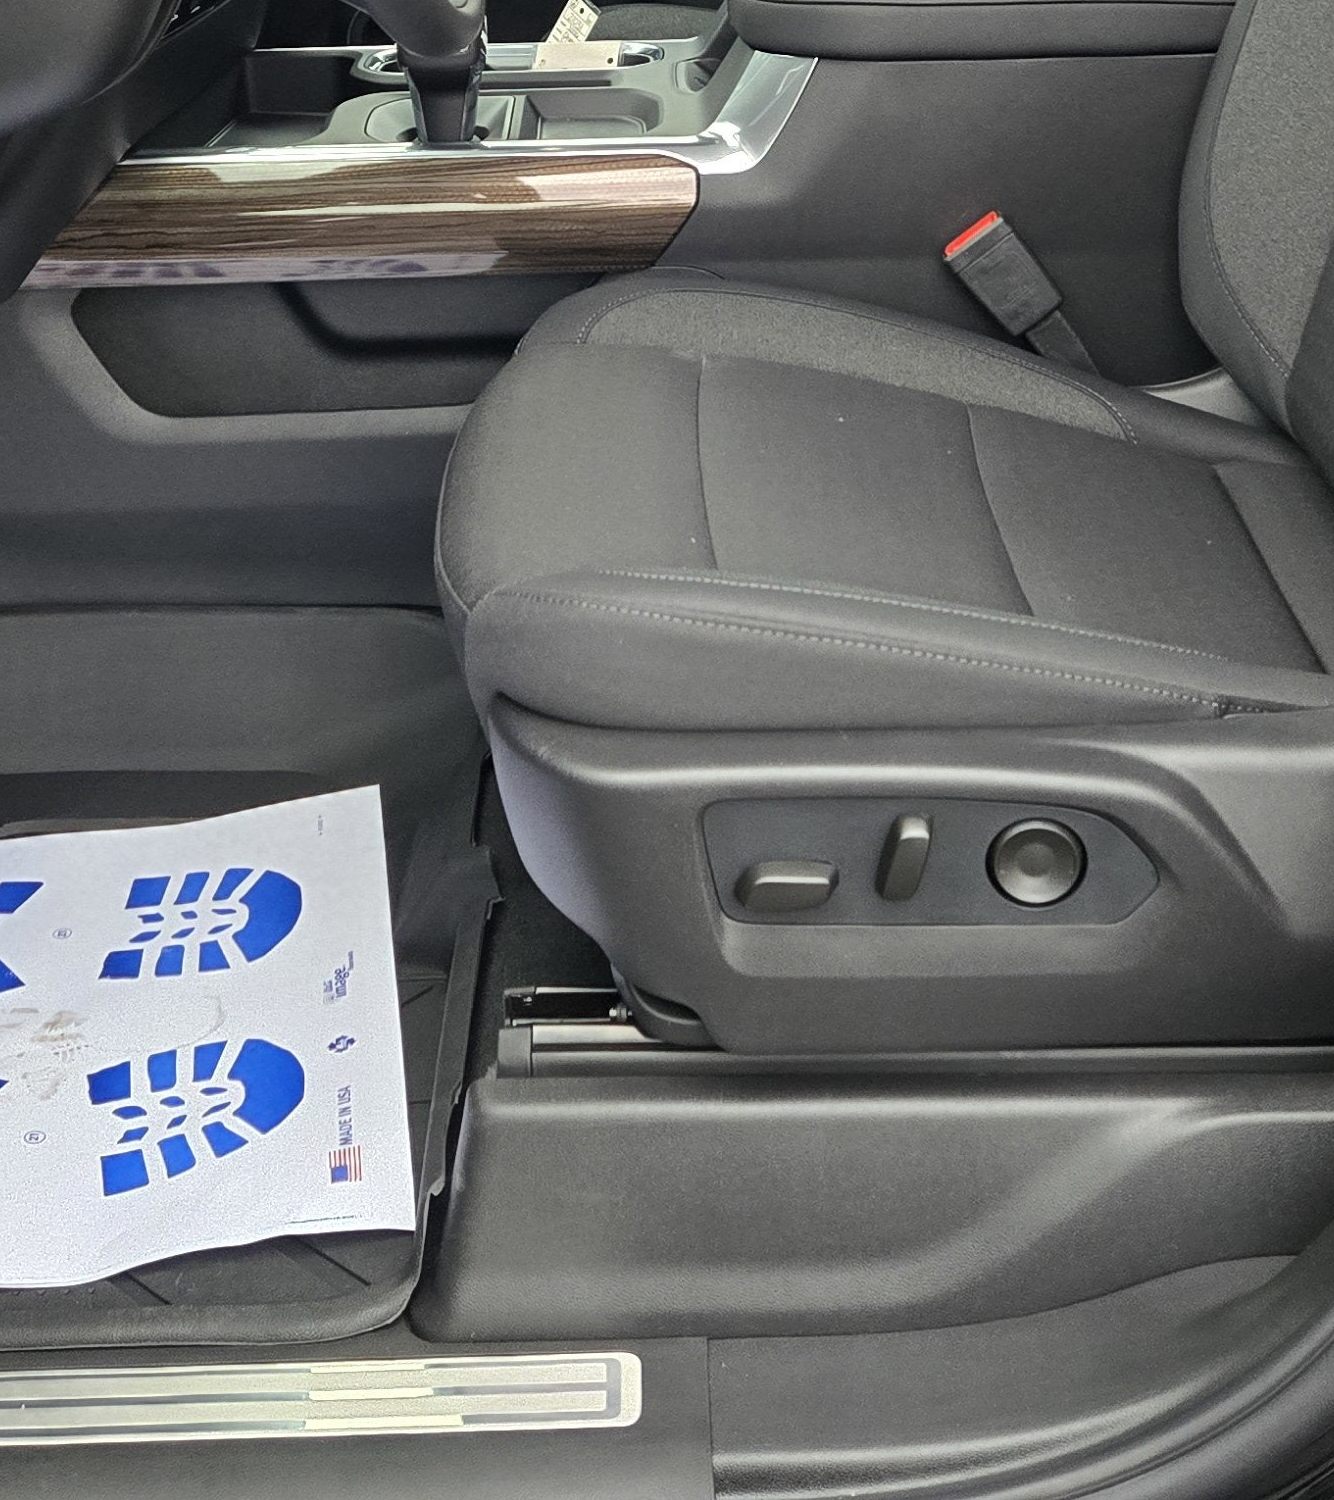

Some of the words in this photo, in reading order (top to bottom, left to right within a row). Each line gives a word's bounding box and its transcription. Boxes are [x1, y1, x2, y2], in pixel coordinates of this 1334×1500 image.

[337, 1084, 351, 1106] USA
[338, 1105, 352, 1117] IN
[338, 1117, 353, 1146] MADE
